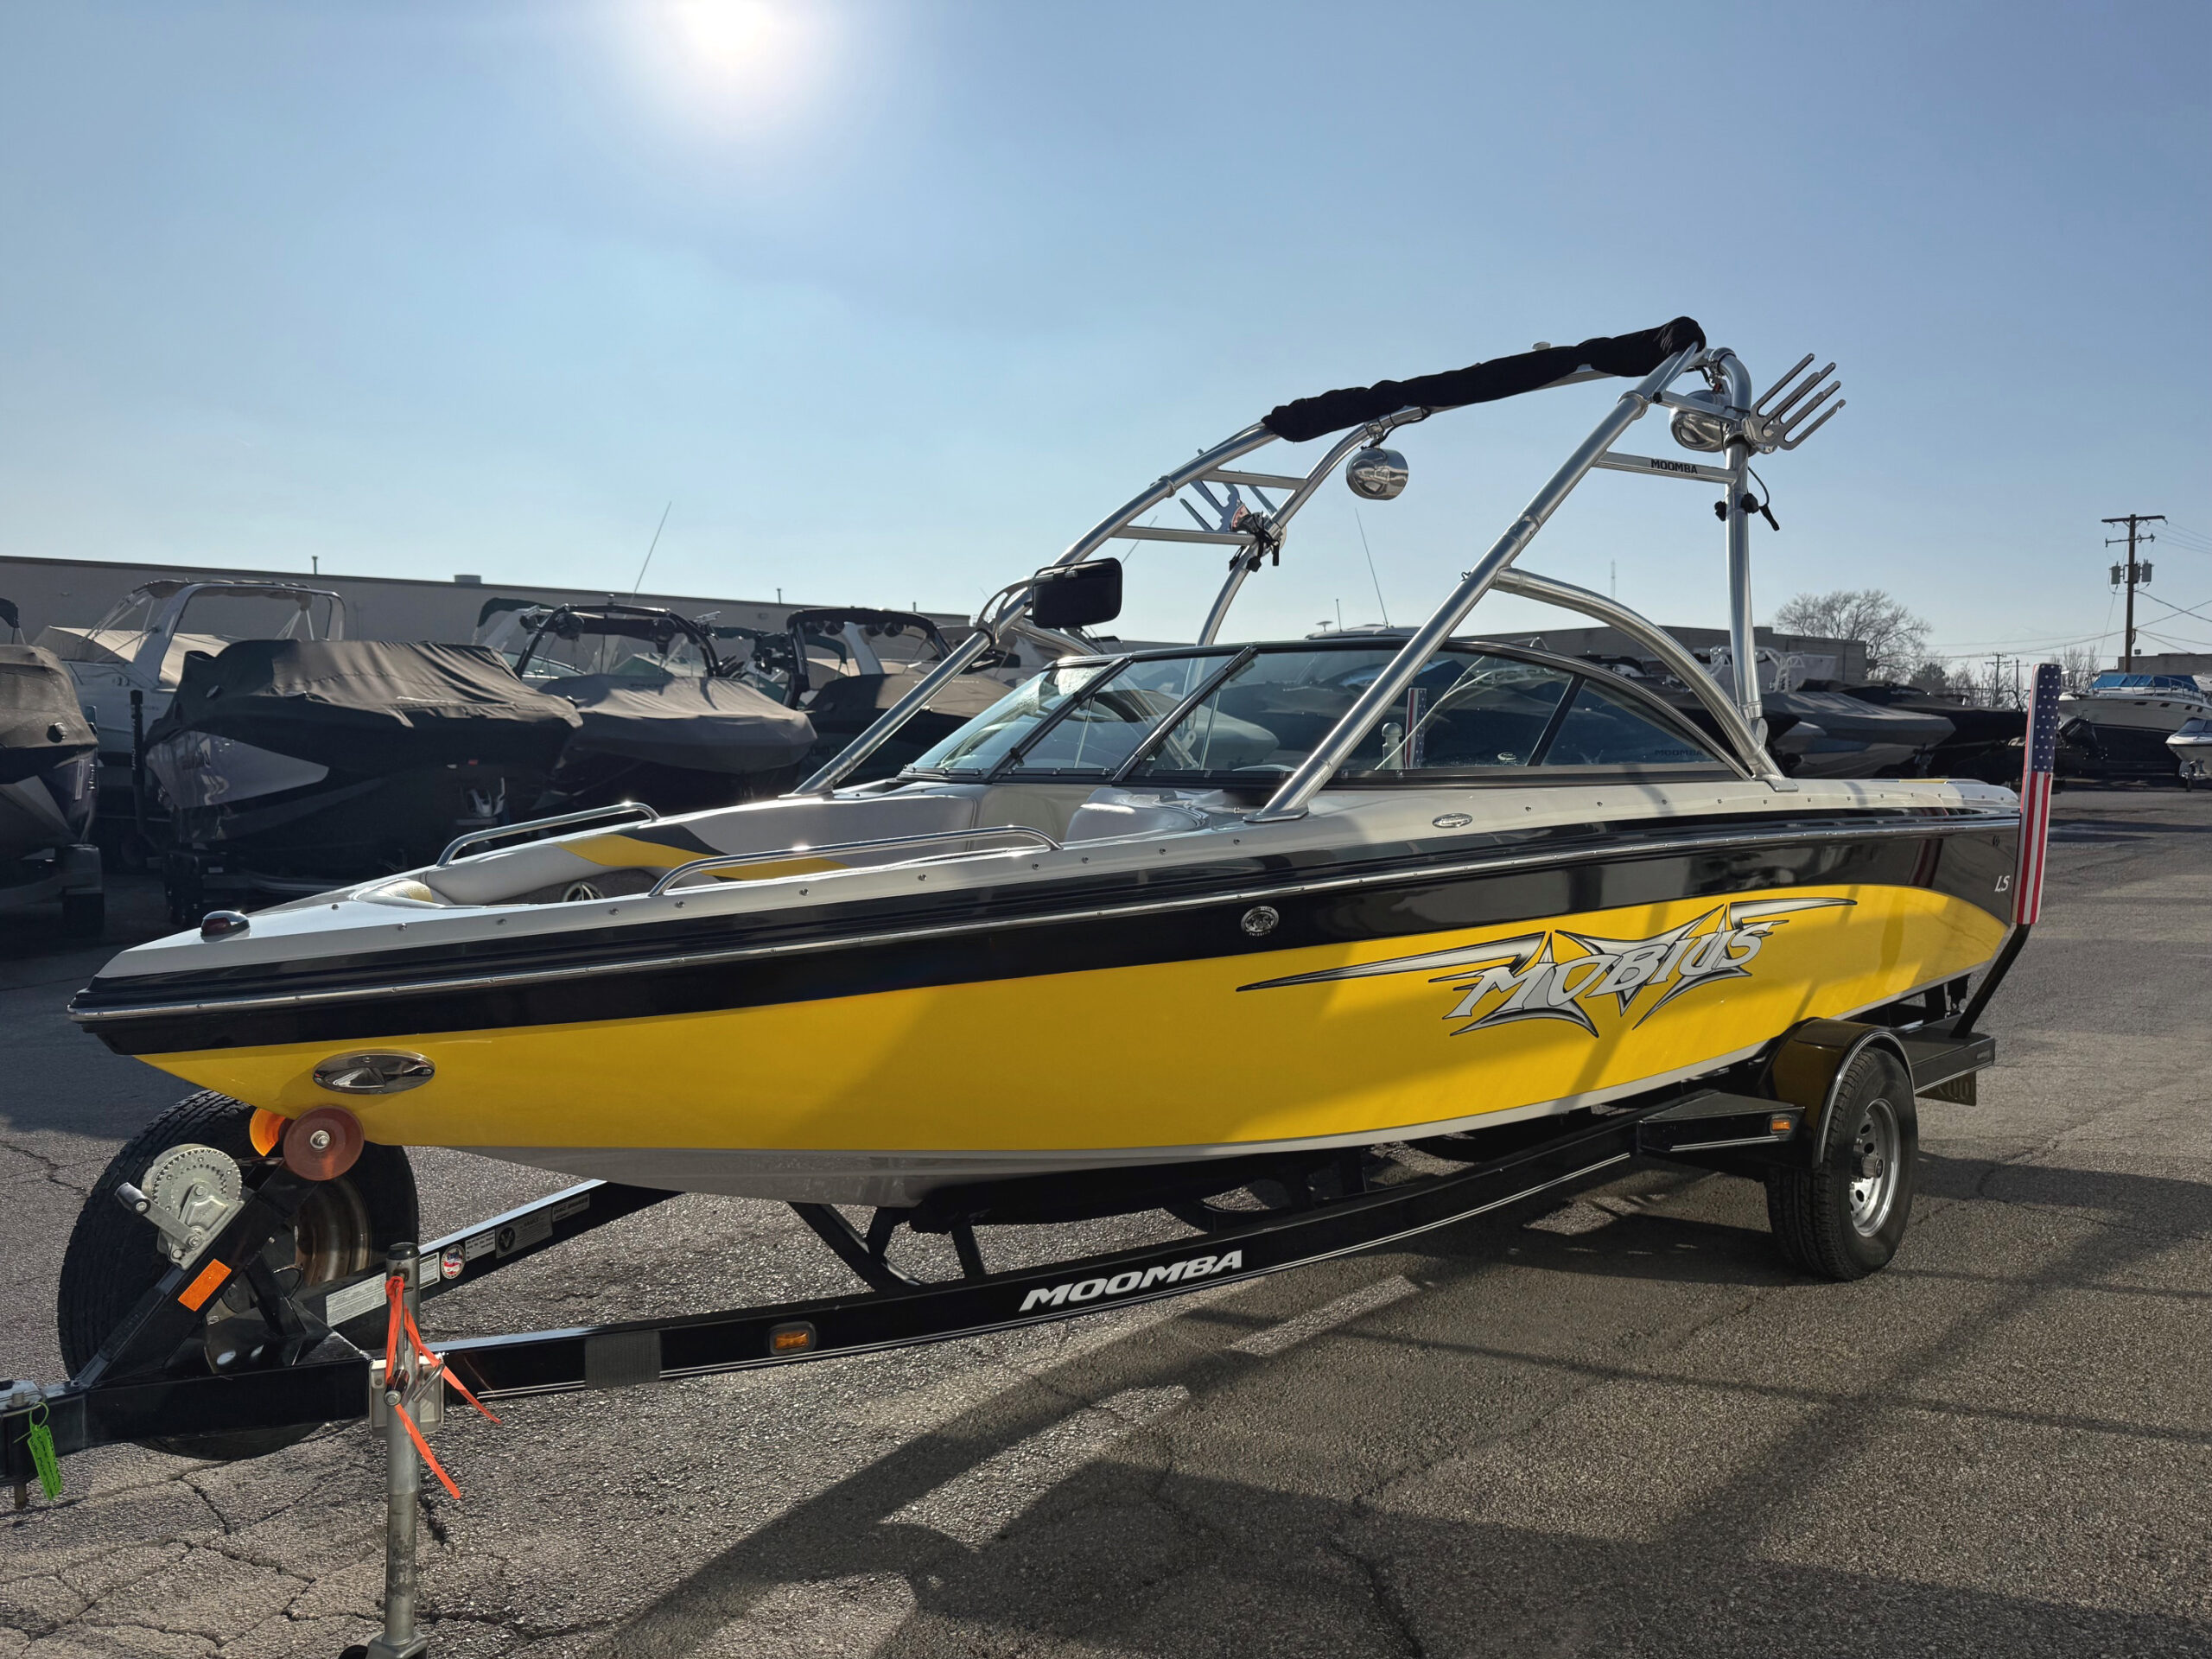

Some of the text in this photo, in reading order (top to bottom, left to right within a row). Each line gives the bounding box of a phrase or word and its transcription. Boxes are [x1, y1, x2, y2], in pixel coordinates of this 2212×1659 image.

[1650, 459, 1698, 474] MOOMBA
[1994, 875, 2010, 892] LS
[1442, 921, 1774, 1020] MOBIUS
[1019, 1249, 1242, 1312] MOOMBA
